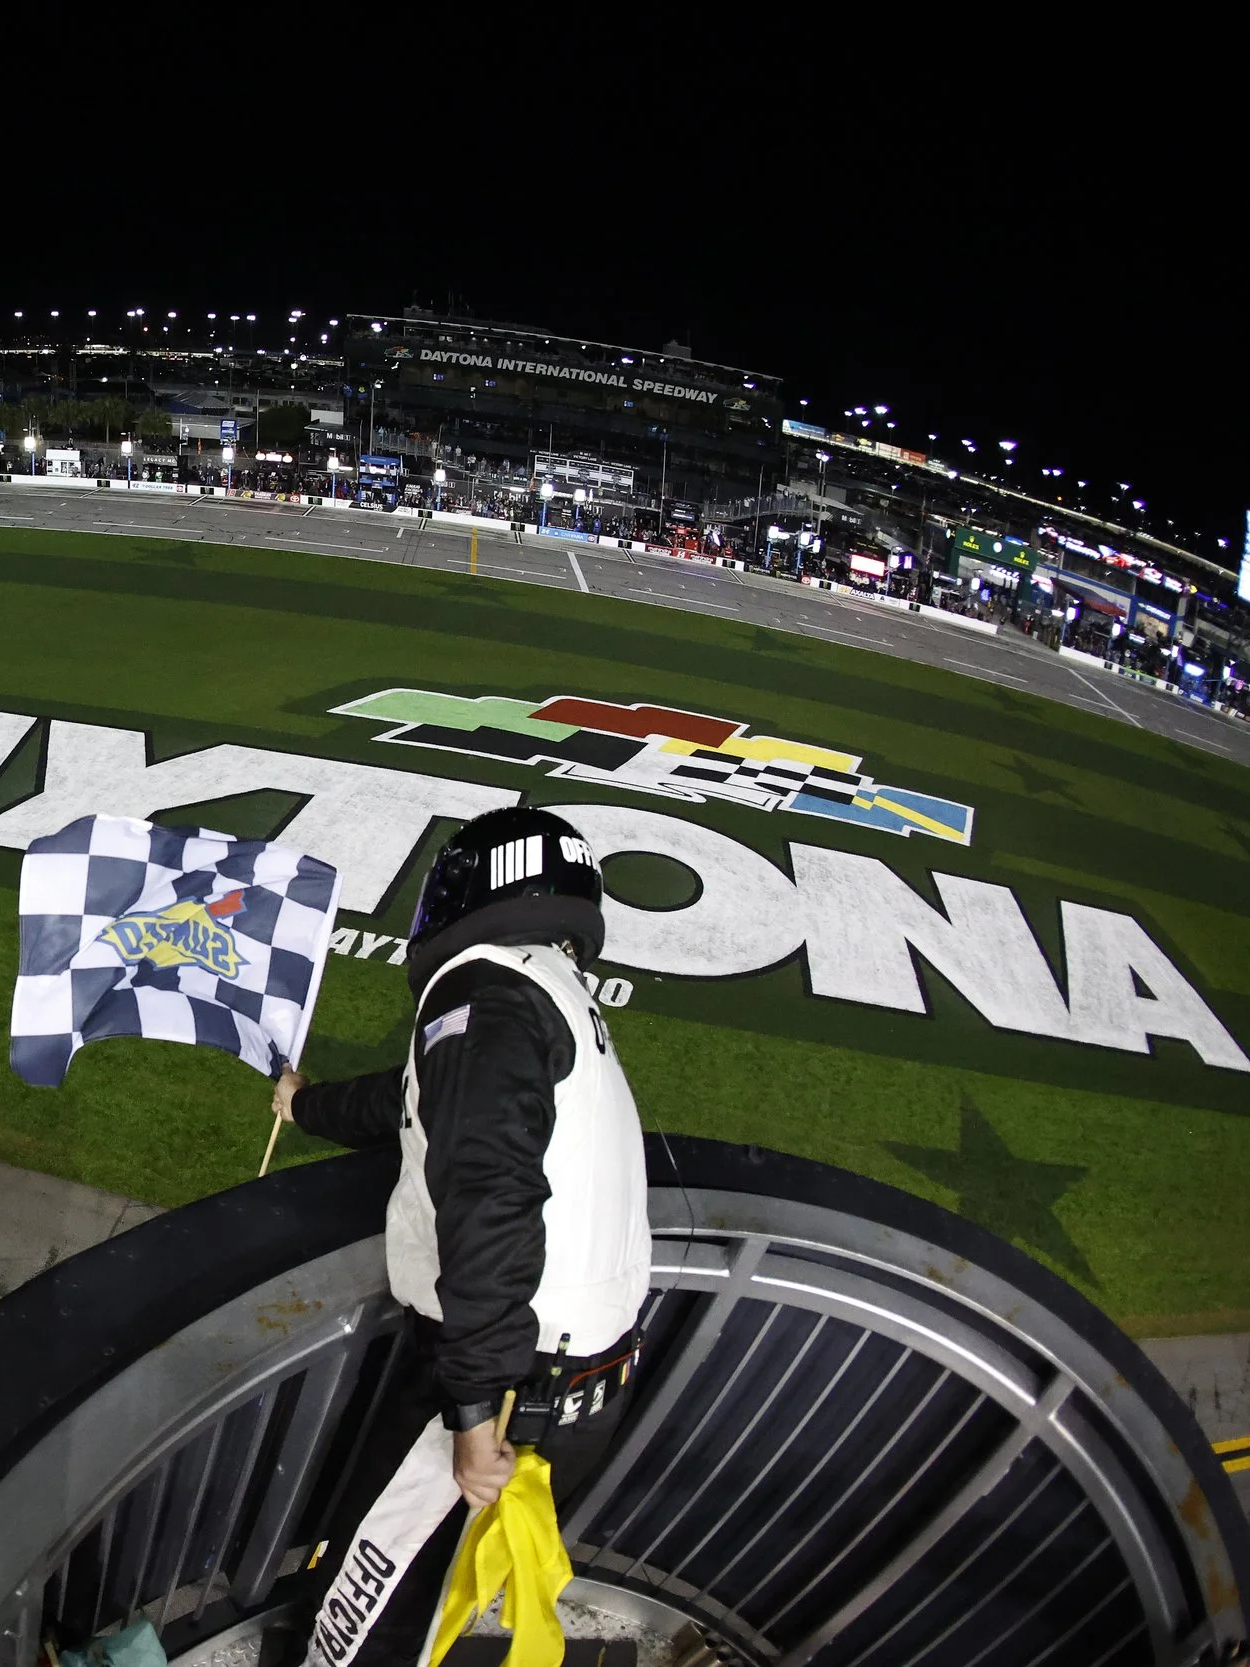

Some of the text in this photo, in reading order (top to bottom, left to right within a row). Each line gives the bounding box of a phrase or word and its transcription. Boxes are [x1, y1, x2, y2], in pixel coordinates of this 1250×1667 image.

[419, 349, 718, 404] DAYTONA INTERNATIONAL SPEEDWAY
[963, 540, 980, 550] ROLEX
[1014, 556, 1030, 566] ROLEX
[850, 589, 875, 600] AXALTA
